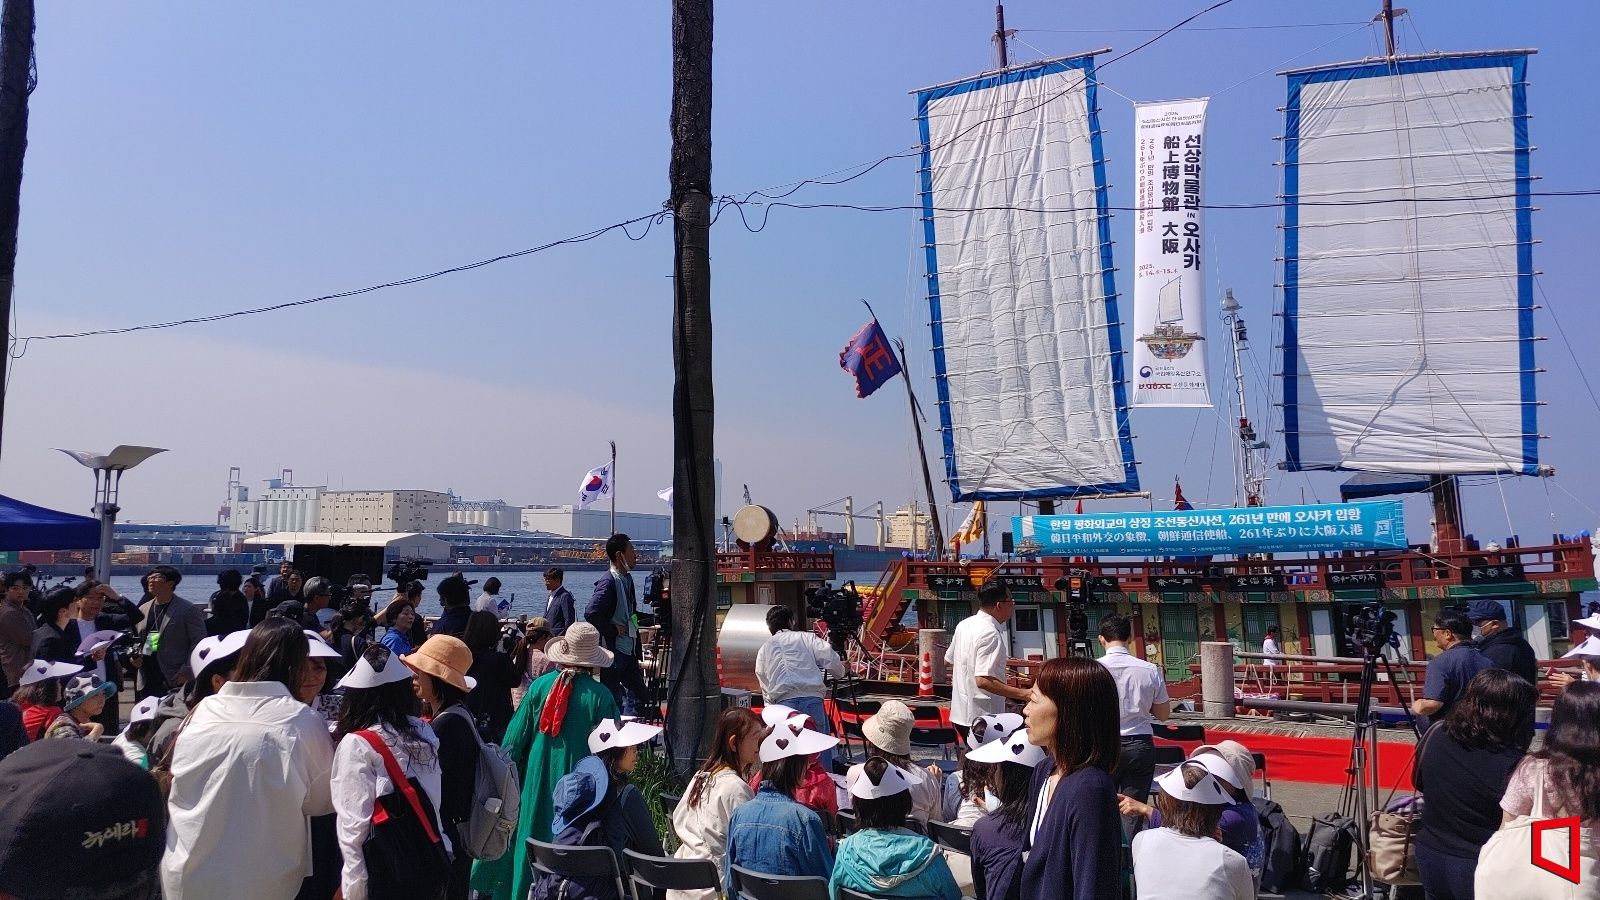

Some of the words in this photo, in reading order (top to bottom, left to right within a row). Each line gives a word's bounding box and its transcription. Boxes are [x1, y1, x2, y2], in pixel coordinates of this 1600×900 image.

[1162, 136, 1180, 212] 船上博物館
[1184, 134, 1201, 211] 선상박물관
[1162, 222, 1179, 254] 大阪
[1183, 221, 1200, 270] 오사카
[1050, 520, 1071, 530] 한일
[1074, 518, 1126, 529] 평화외교의
[1129, 517, 1150, 528] 상징
[1154, 514, 1225, 528] 조선통신사선,
[1229, 513, 1264, 525] 261년
[1267, 512, 1291, 523] 만에
[1294, 510, 1332, 523] 오사카
[1335, 508, 1361, 520] 입항
